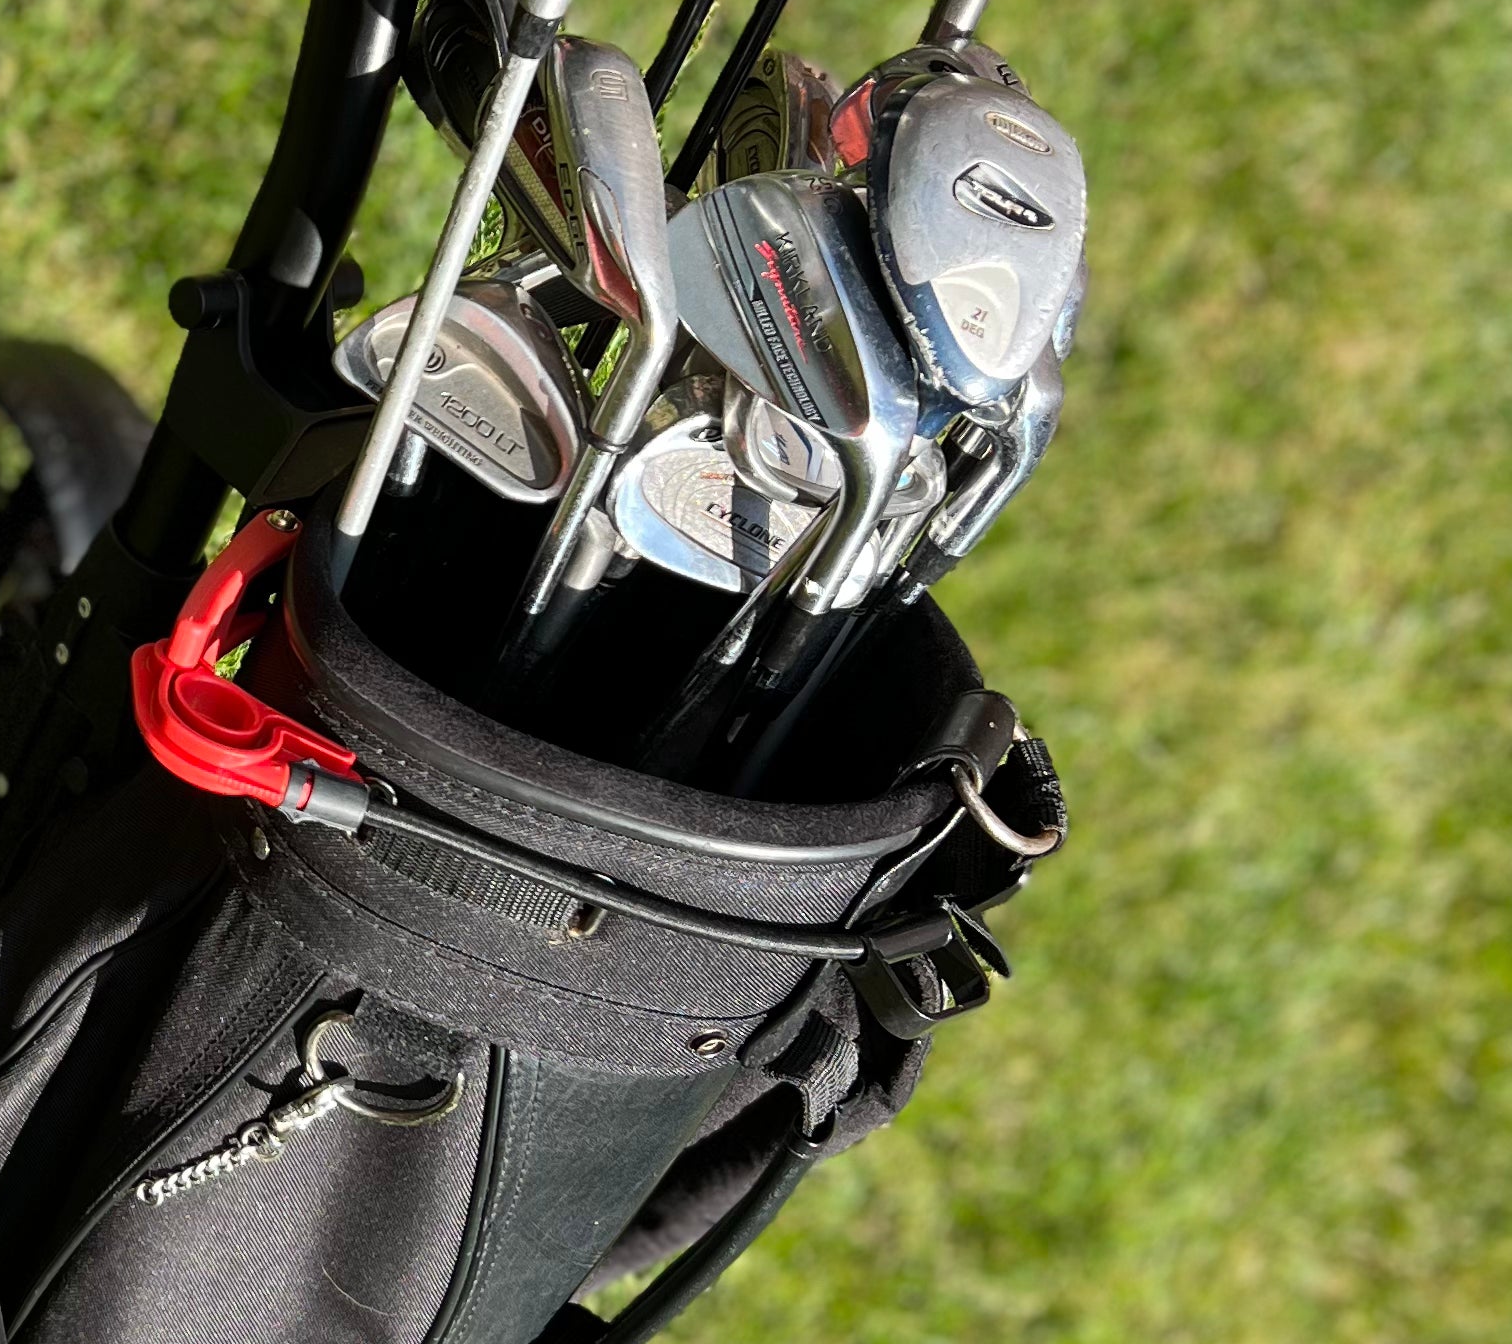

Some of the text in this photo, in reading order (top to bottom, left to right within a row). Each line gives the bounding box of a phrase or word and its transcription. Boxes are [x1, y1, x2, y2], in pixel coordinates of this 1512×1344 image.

[754, 240, 809, 364] Signature
[775, 231, 833, 354] KIRKLAND
[972, 306, 988, 323] 21
[960, 318, 986, 339] DEG
[768, 336, 789, 363] FACE
[780, 360, 820, 423] TECHNOLOGY
[440, 391, 526, 456] 1200 LT
[706, 501, 787, 550] CYCLONE
